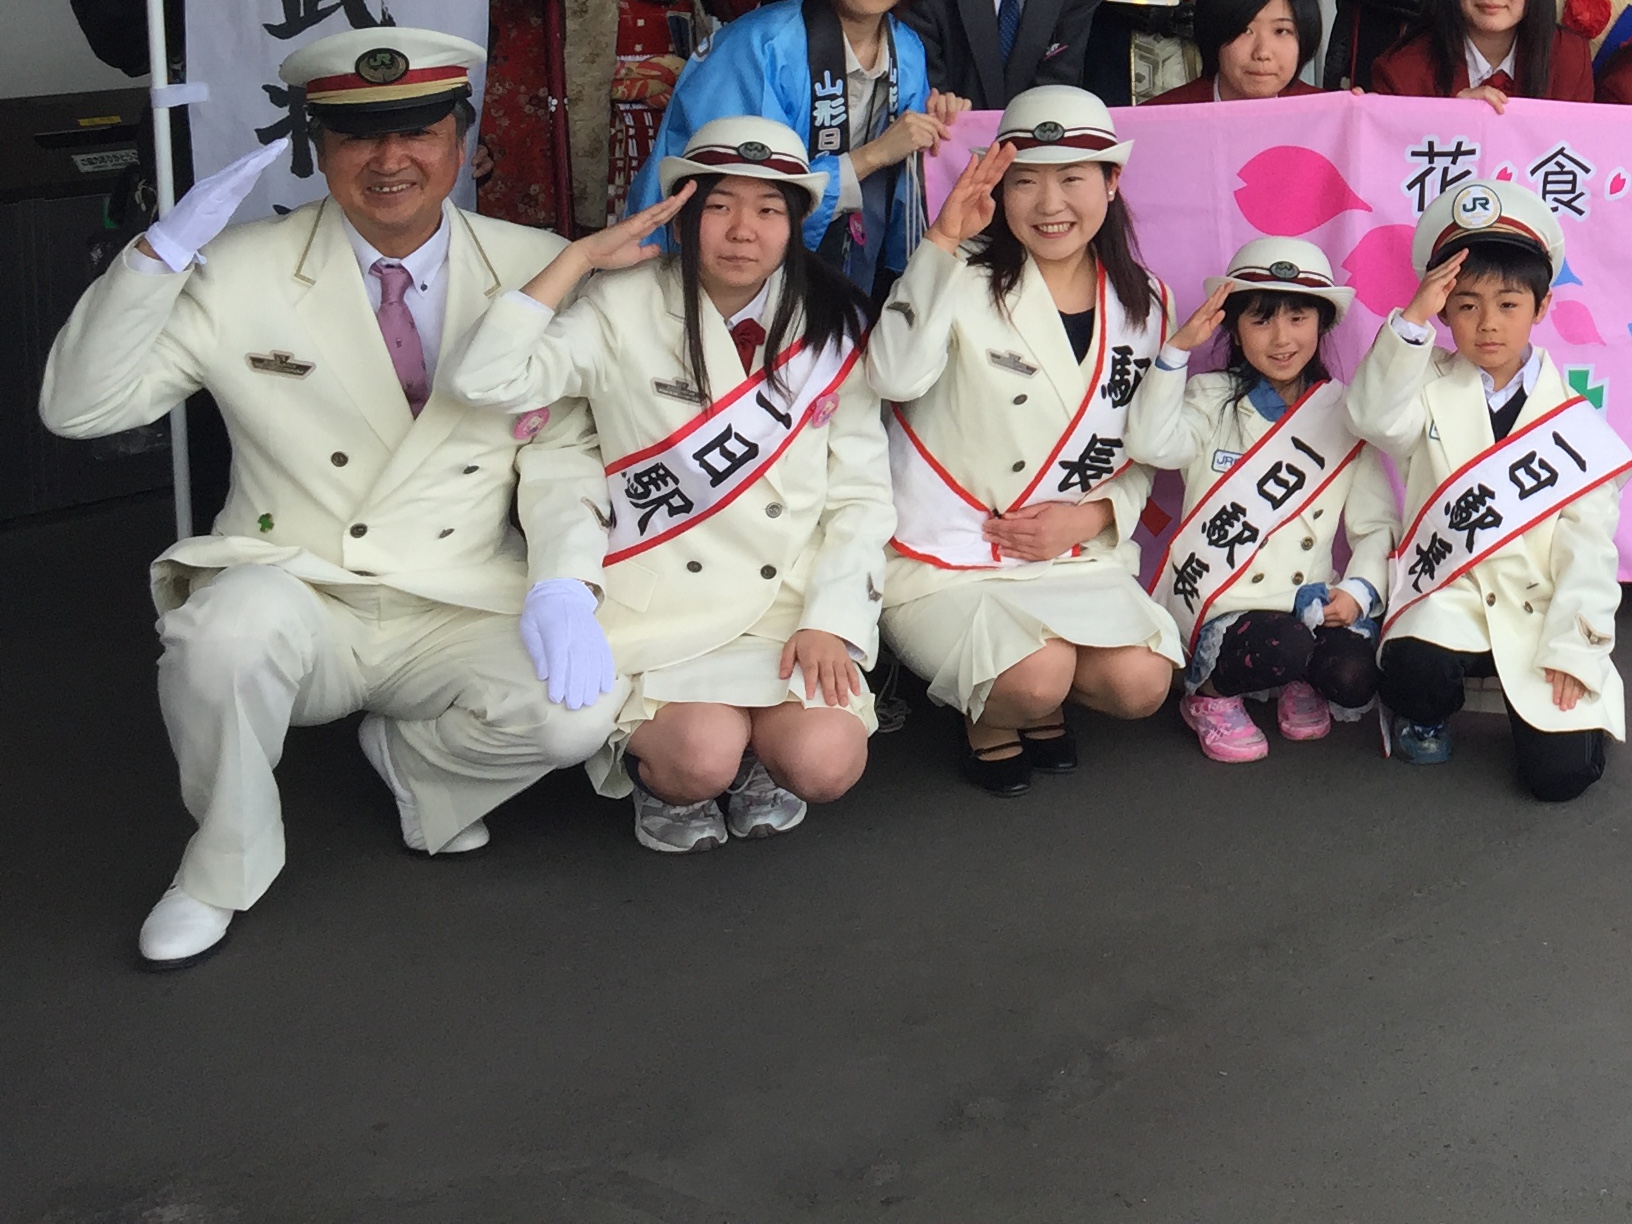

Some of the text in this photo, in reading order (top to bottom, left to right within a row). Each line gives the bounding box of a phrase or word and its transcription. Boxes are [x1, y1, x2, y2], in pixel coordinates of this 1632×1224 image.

[812, 68, 848, 158] 山形日
[1462, 196, 1490, 213] JR
[1172, 435, 1326, 615] 一日駅長
[1408, 430, 1588, 594] 一日駅長
